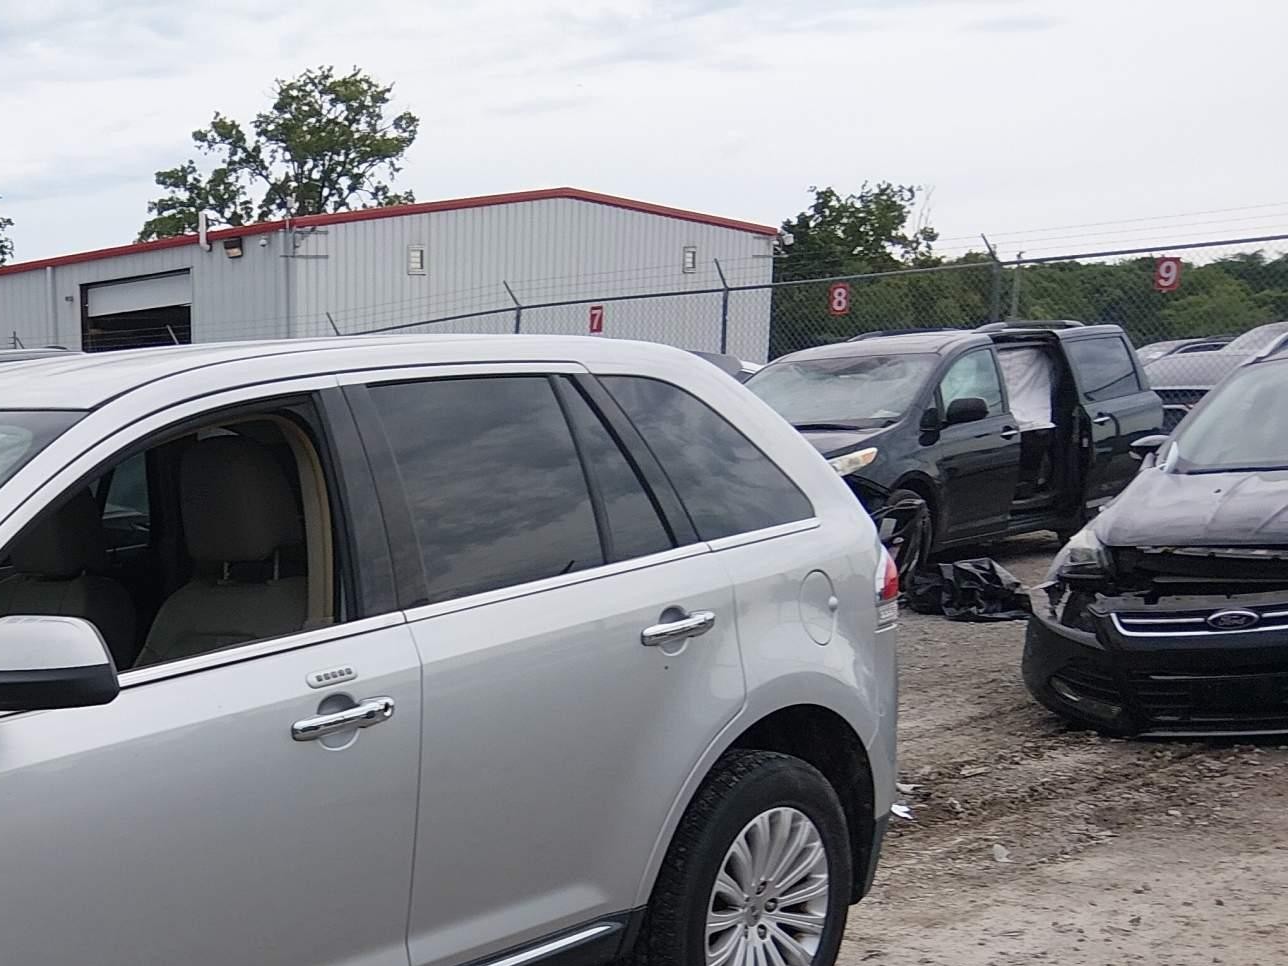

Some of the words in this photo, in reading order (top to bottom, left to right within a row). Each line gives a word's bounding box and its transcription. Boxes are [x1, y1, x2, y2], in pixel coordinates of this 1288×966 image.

[1158, 260, 1177, 287] 9
[832, 287, 847, 311] 8
[591, 309, 602, 330] 7
